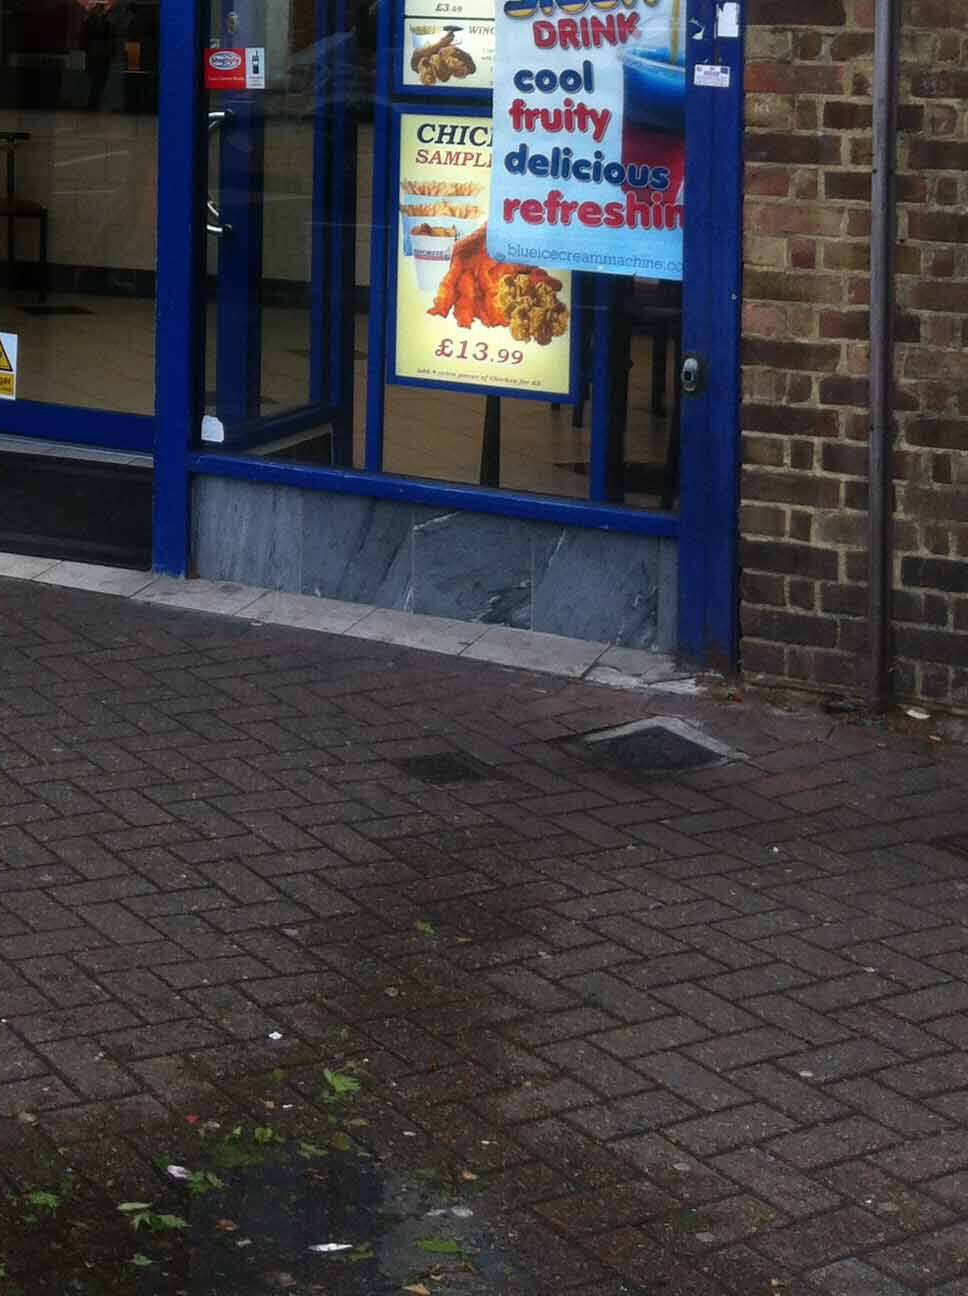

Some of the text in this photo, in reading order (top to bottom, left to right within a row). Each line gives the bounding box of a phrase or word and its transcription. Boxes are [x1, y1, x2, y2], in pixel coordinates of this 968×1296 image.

[532, 11, 641, 50] DRINK
[513, 60, 594, 94] cool
[509, 98, 611, 143] fruity
[504, 143, 670, 190] delicious
[435, 338, 524, 365] £13.99
